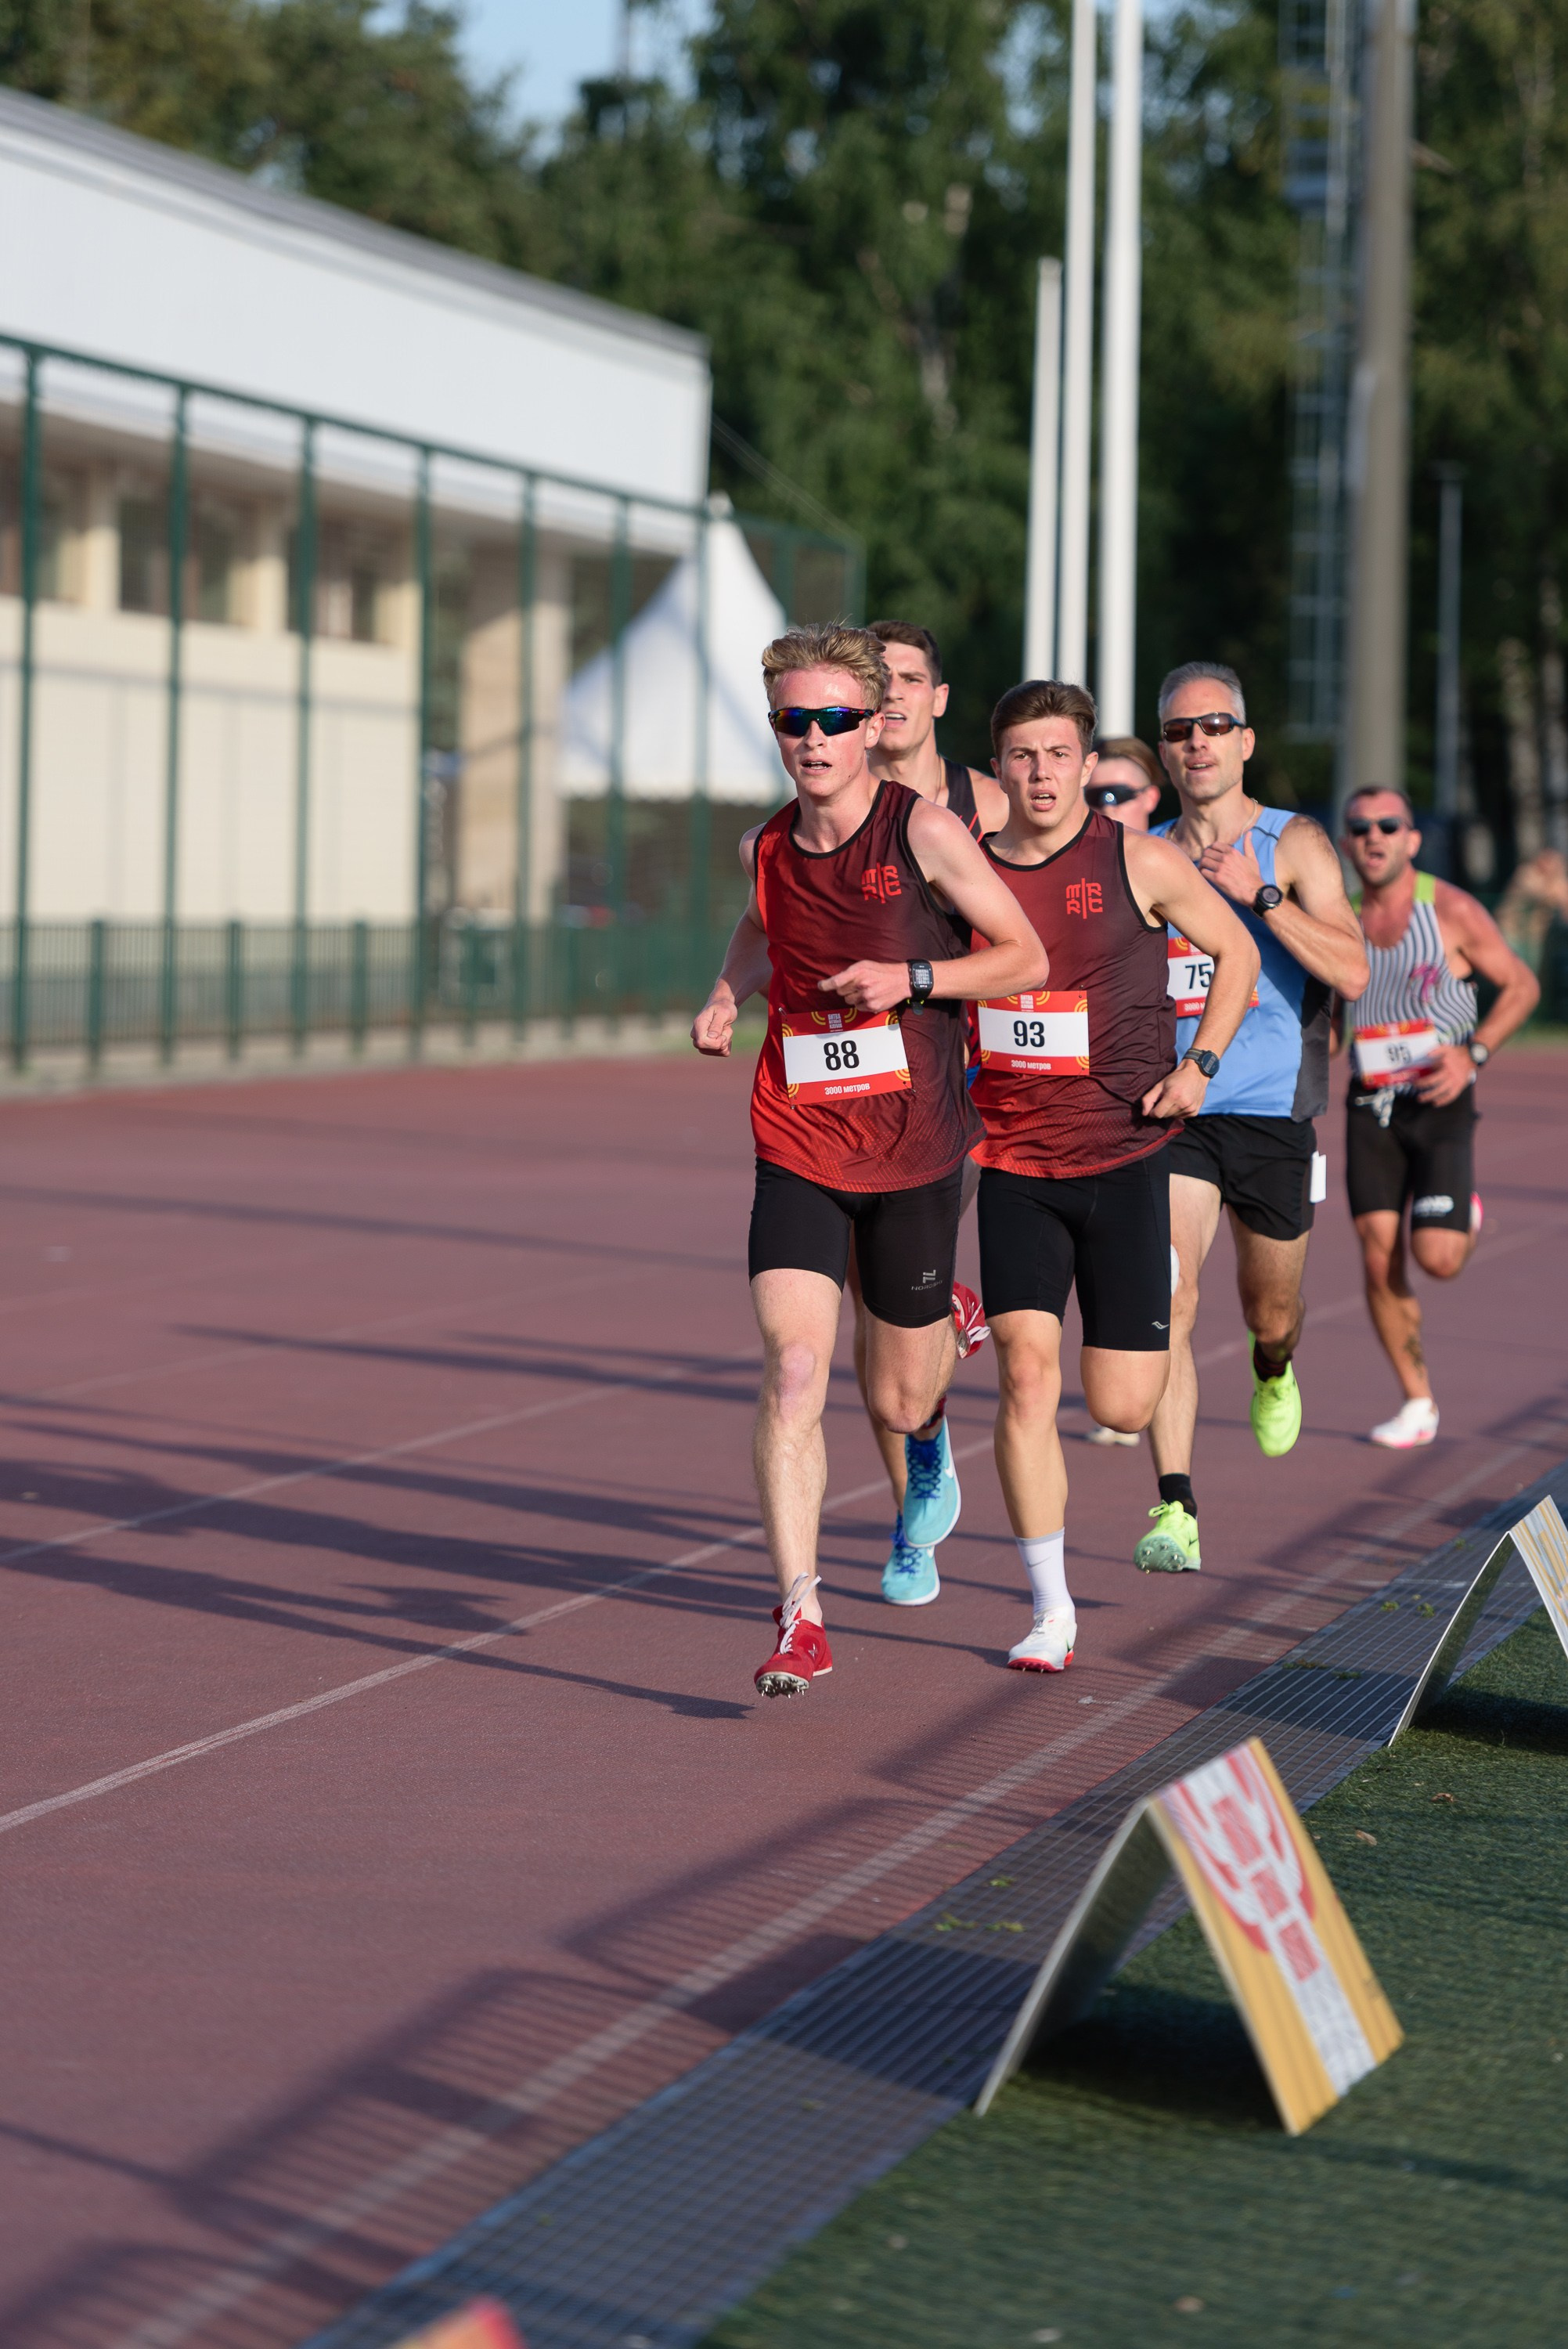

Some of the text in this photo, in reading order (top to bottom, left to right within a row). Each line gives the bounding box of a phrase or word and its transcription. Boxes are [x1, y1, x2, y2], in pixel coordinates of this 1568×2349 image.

[1184, 962, 1213, 990] 75
[1013, 1019, 1045, 1048] 93
[823, 1040, 860, 1071] 88
[1011, 1059, 1052, 1071] 3000 метров
[824, 1083, 871, 1095] 3000 метров
